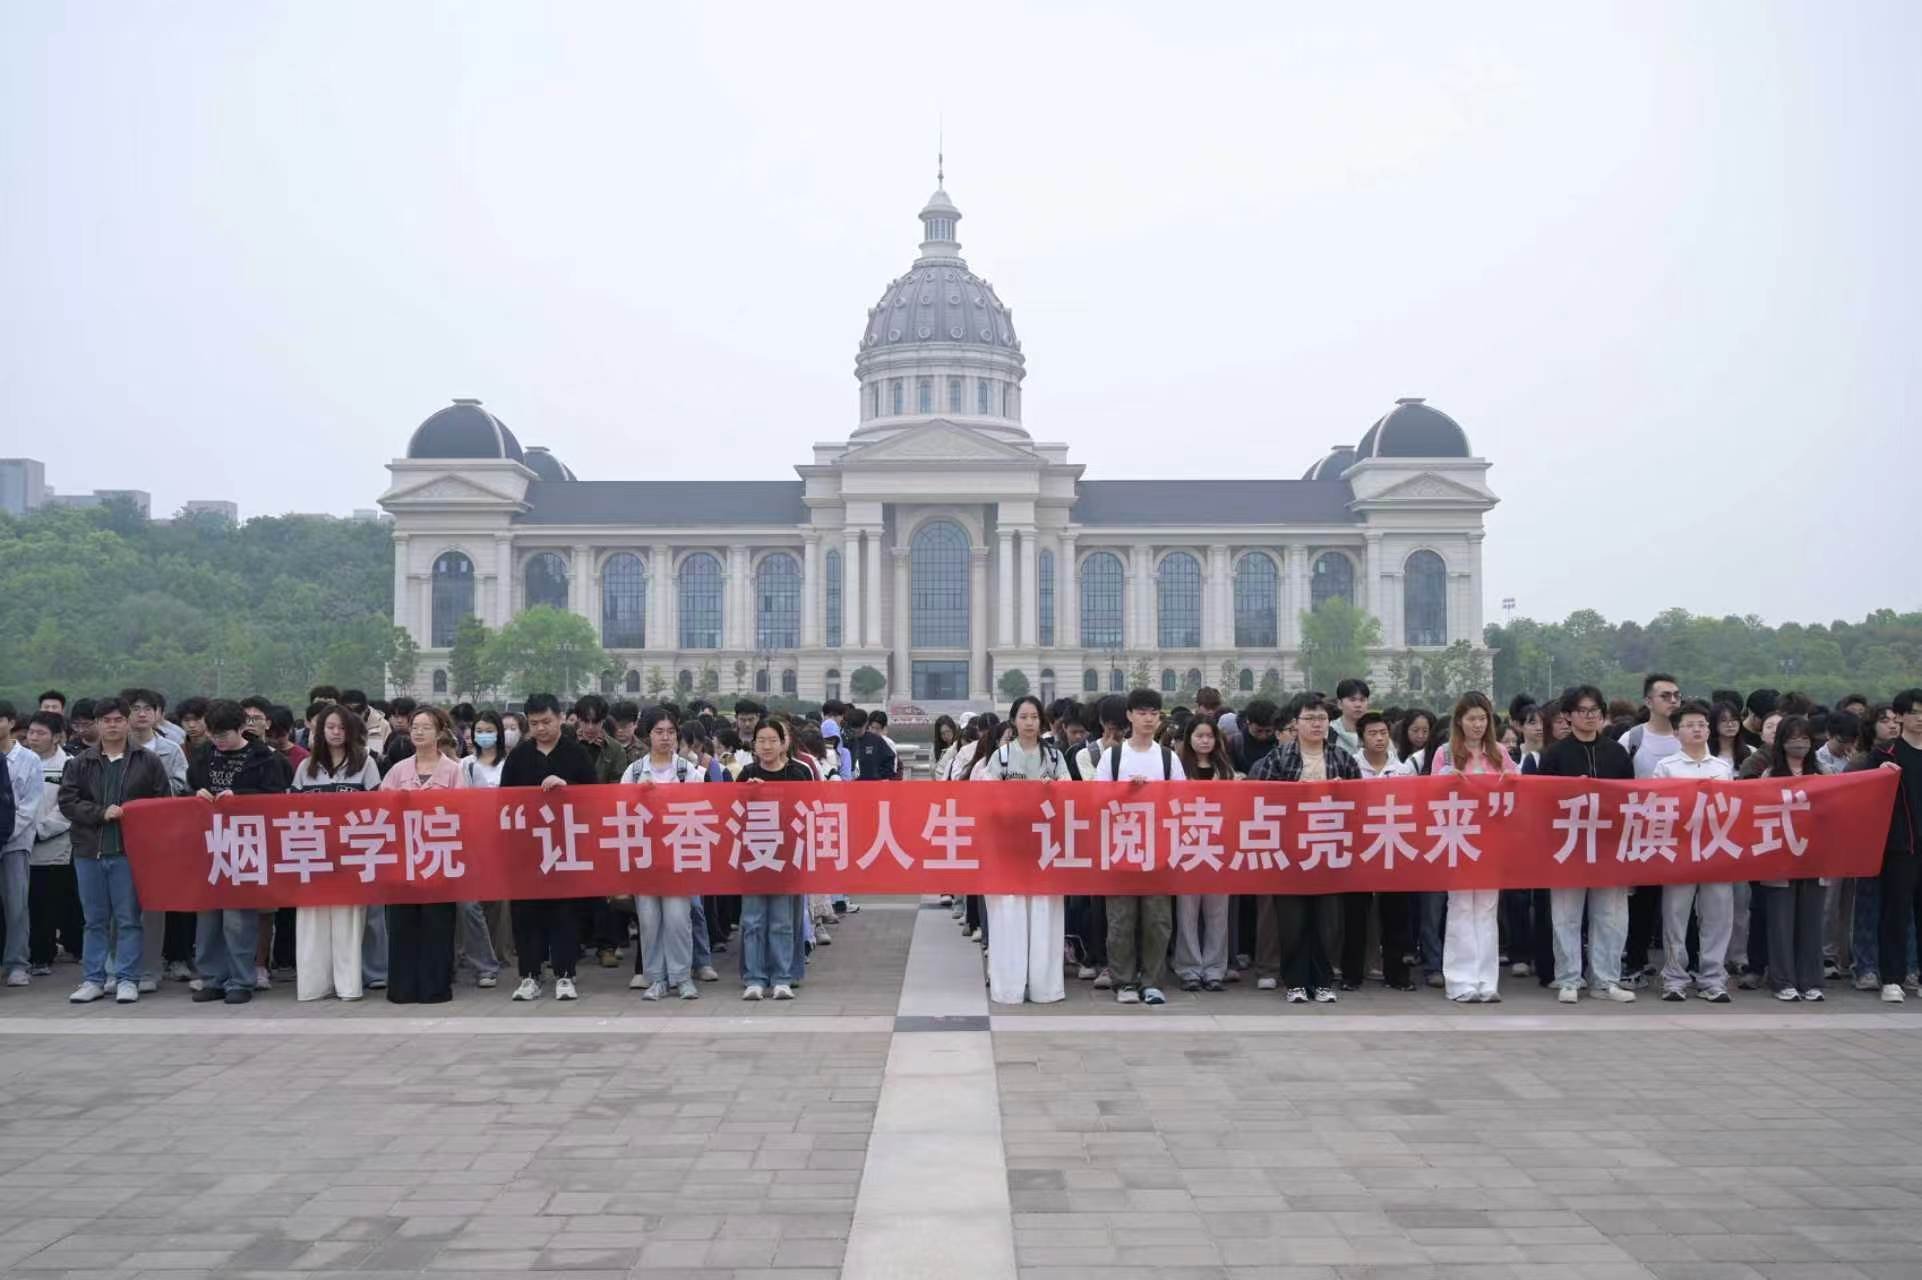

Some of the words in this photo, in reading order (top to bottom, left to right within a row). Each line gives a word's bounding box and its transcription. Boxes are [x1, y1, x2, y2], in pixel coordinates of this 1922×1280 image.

[205, 808, 466, 885] 烟草学院
[500, 800, 978, 872] “让书香浸润人生
[1033, 795, 1514, 871] 让阅读点亮未来”
[1553, 788, 1808, 867] 升旗仪式
